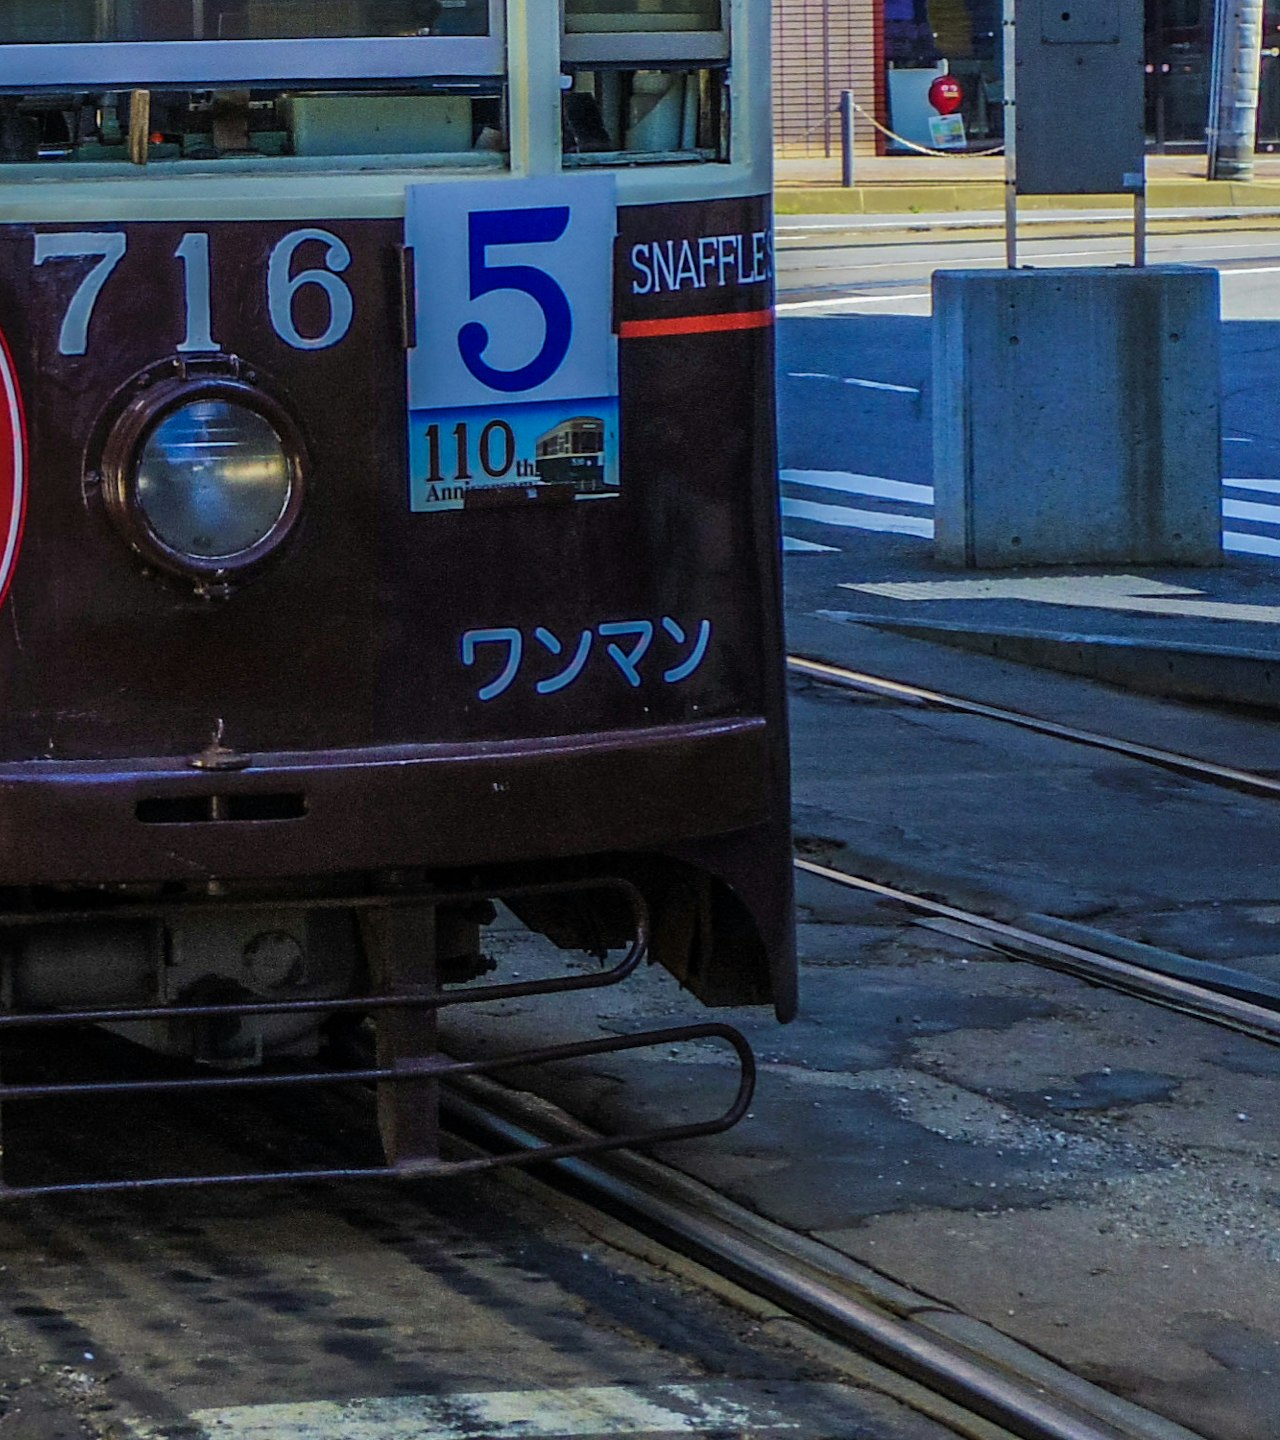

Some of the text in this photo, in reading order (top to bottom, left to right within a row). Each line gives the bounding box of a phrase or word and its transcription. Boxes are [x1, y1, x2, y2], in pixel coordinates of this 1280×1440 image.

[33, 227, 355, 356] 716
[457, 206, 573, 393] 5
[461, 615, 711, 702] ワンマン
